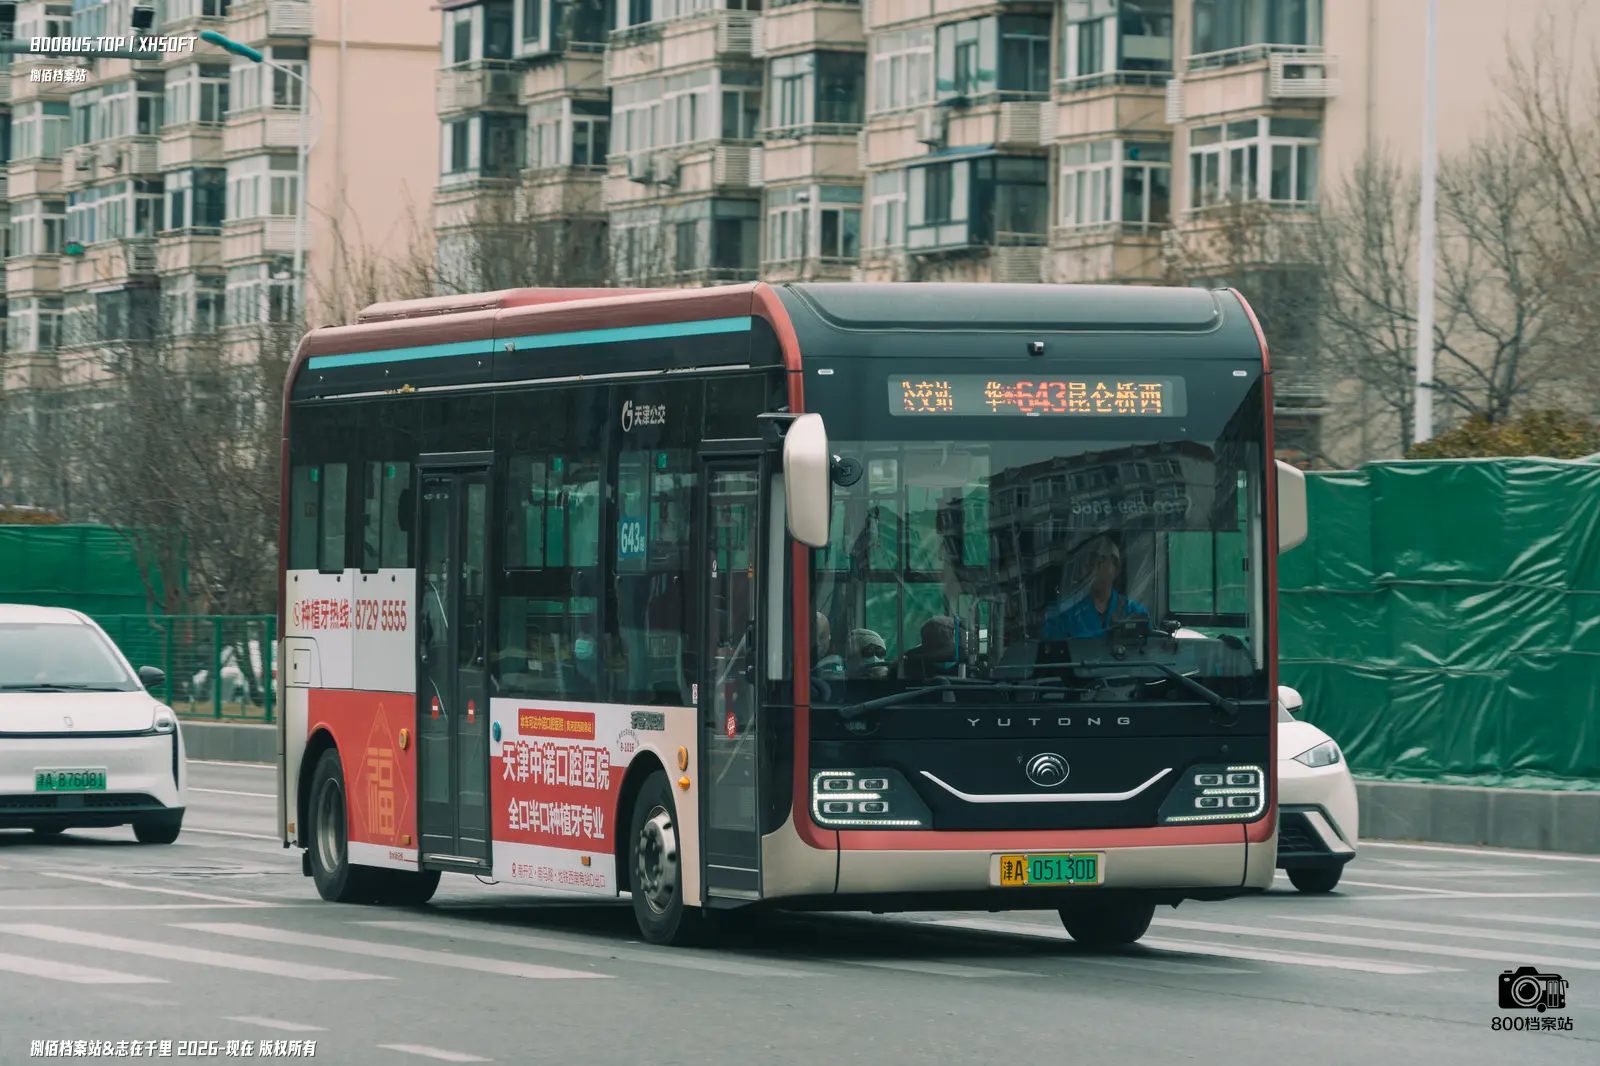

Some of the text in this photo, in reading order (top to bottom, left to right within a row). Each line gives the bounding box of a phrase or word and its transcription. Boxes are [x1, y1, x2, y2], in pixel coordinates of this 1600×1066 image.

[634, 404, 666, 425] 天津公交
[355, 598, 379, 631] 8729
[381, 599, 407, 632] 5555
[967, 716, 1131, 727] YUTONG
[502, 740, 610, 791] 天津中诺口腔医院
[508, 797, 605, 839] 全口半口种植牙专业
[1003, 858, 1096, 881] 津A 05130D
